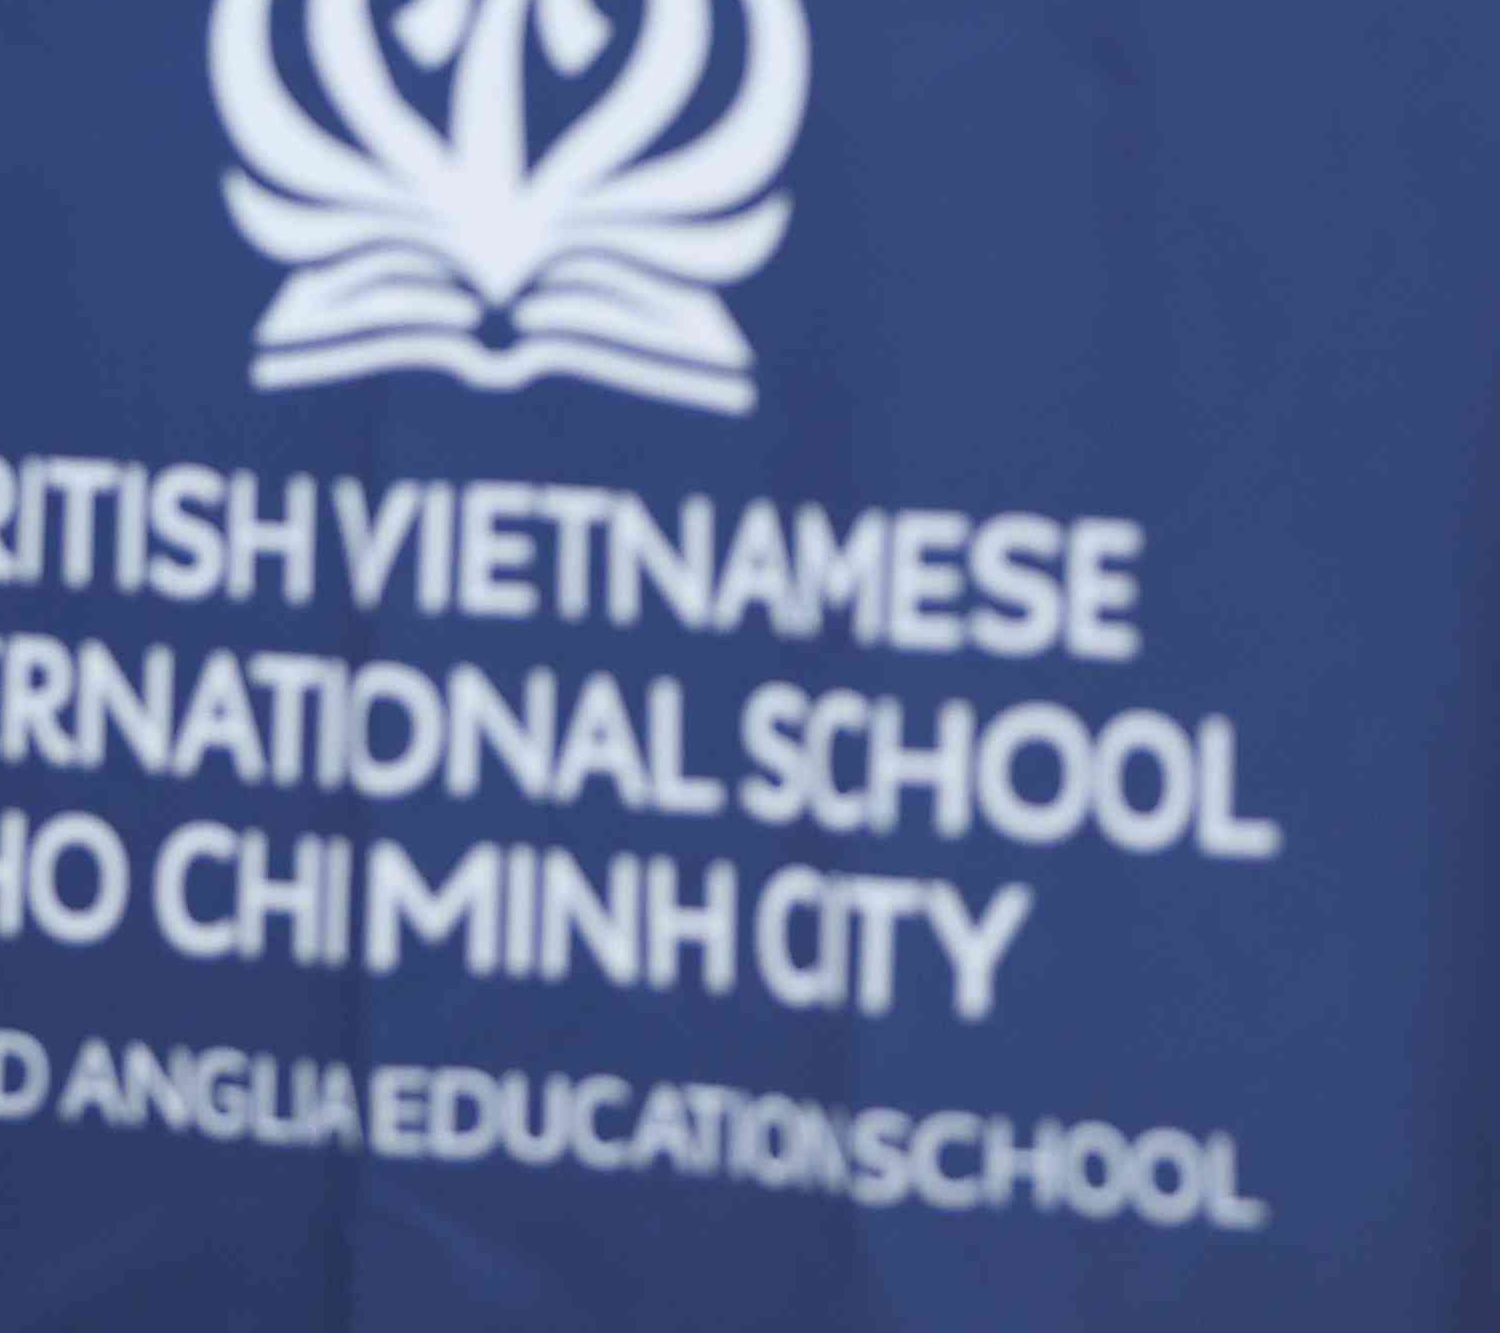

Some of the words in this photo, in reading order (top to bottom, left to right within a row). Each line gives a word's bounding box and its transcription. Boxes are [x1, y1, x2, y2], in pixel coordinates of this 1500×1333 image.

[334, 478, 1143, 661] VIETNAMESE
[740, 682, 1281, 858] SCHOOL
[154, 821, 351, 965] CHI
[365, 840, 737, 993] MINH
[756, 866, 1031, 1020] CITY
[60, 1040, 364, 1149] ANGLIA
[369, 1066, 848, 1195] EDUCATION
[846, 1107, 1266, 1229] SCHOOL
